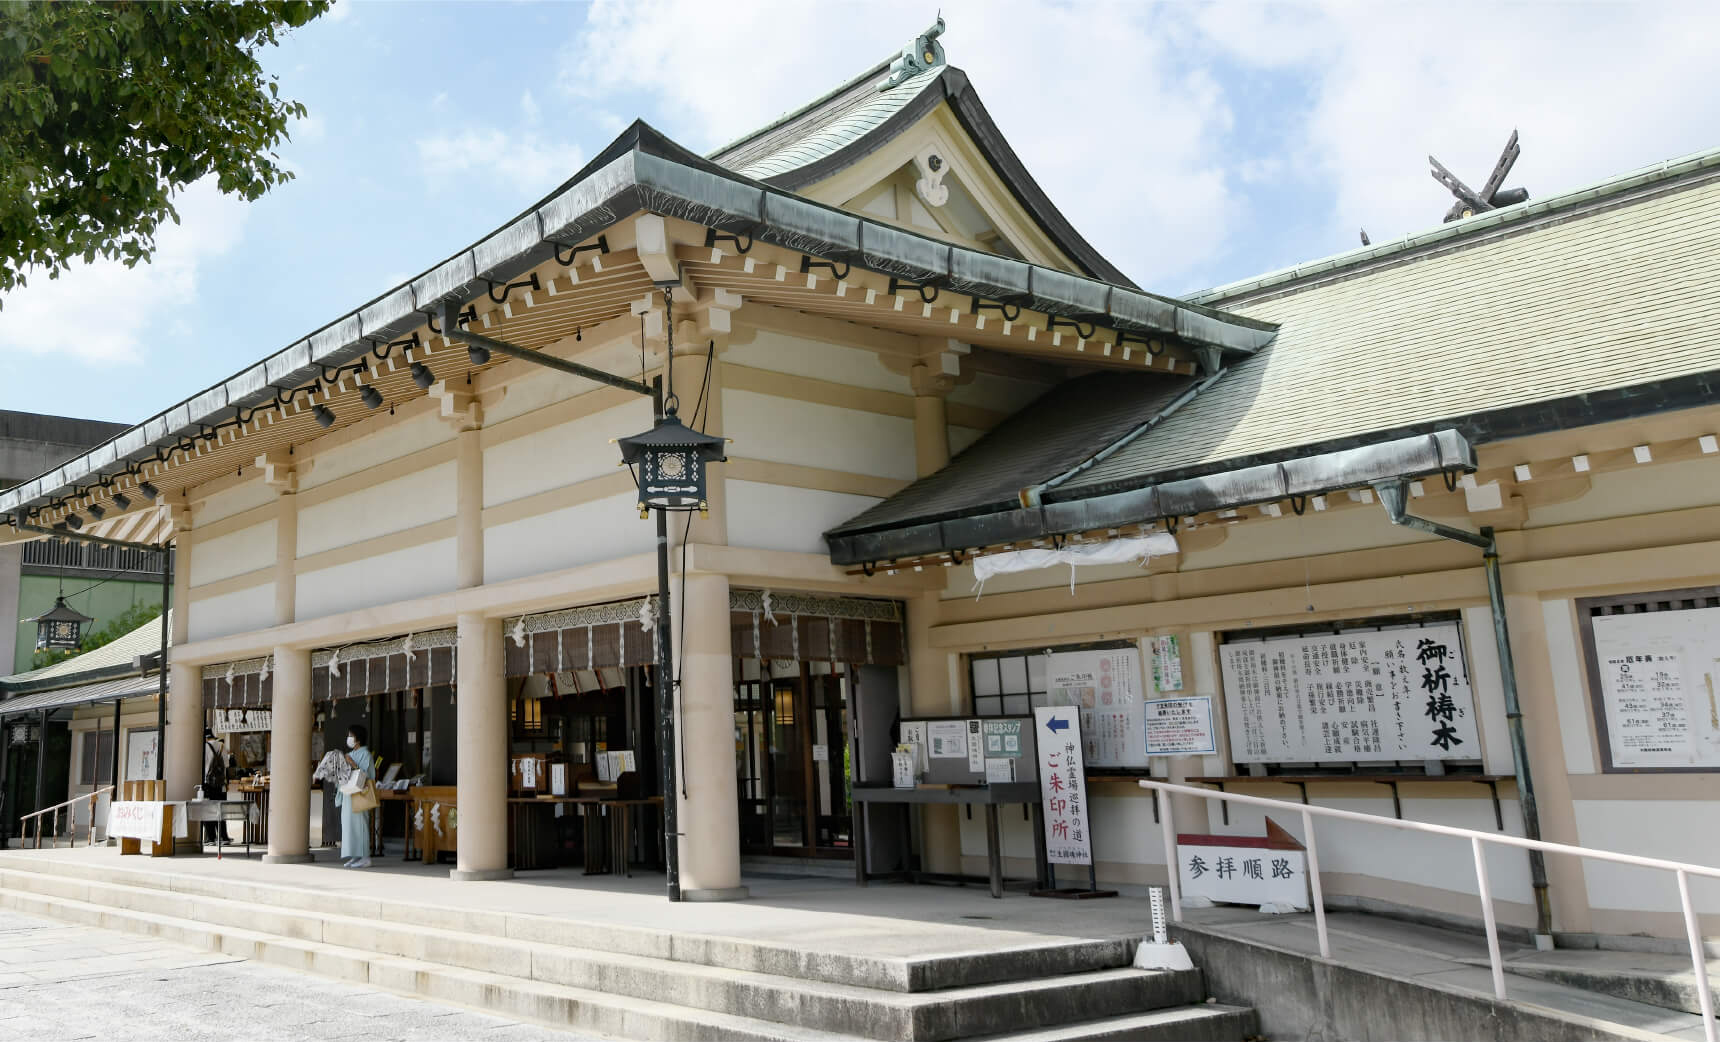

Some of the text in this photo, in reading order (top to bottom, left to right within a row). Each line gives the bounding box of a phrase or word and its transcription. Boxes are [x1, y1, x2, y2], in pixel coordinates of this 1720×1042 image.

[1416, 638, 1463, 751] 御祈祷木
[1048, 752, 1069, 841] ご朱印所
[1189, 855, 1294, 880] 参拝順路
